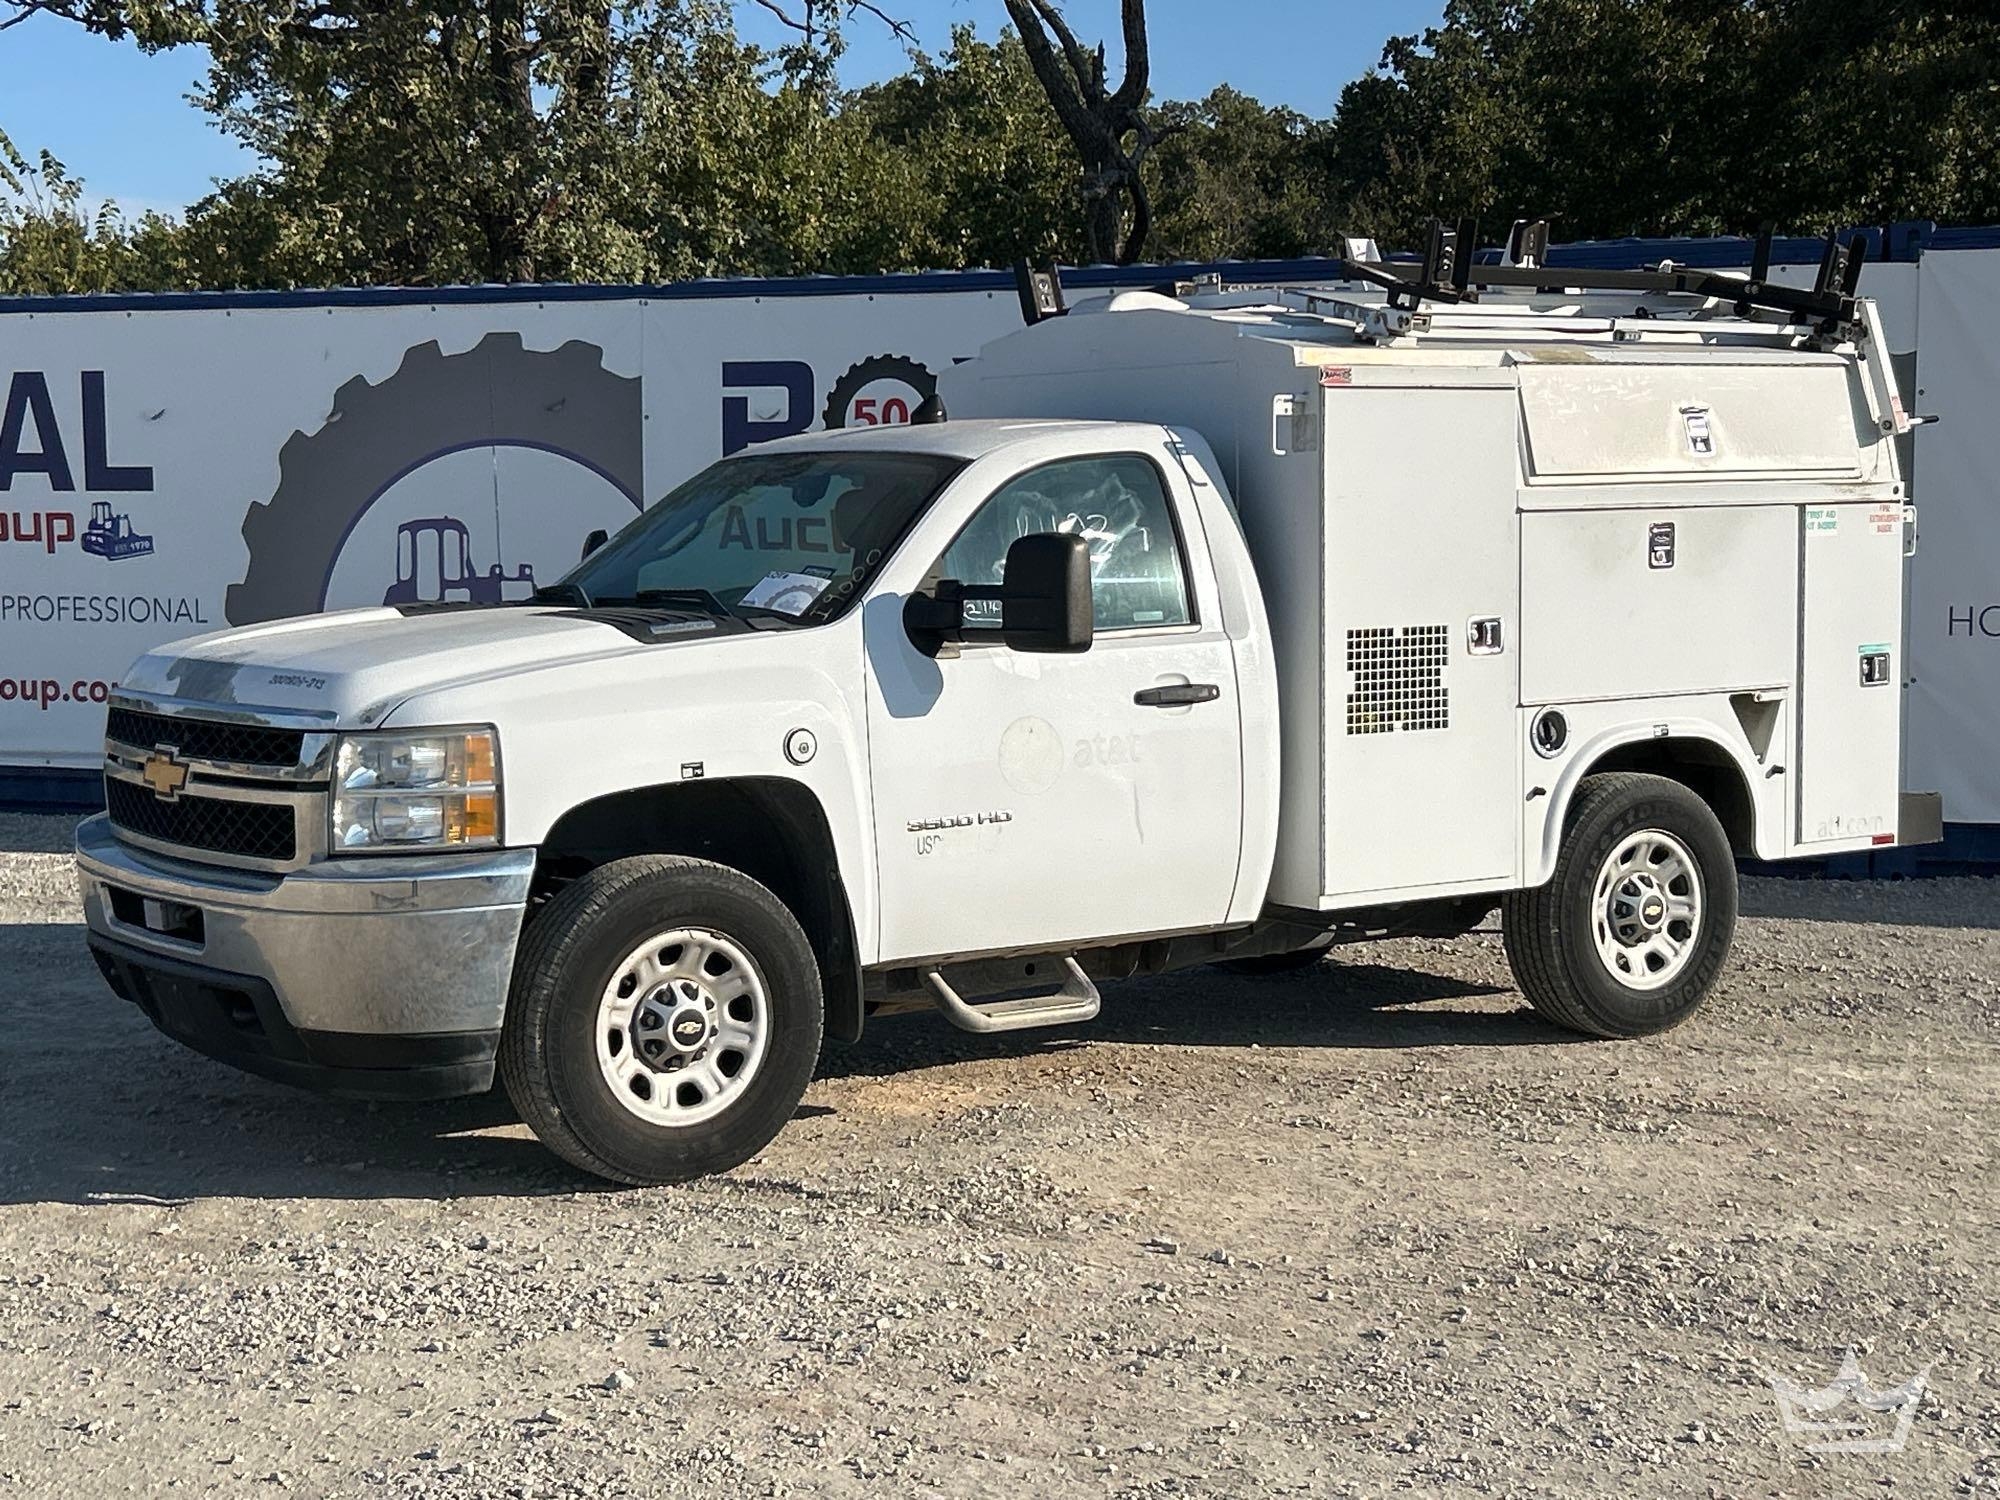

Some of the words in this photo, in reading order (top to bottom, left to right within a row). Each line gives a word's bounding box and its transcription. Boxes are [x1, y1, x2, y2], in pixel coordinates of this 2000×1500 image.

[854, 398, 909, 425] 50
[1, 595, 209, 624] PROFESSIONAL
[0, 678, 120, 711] oup.co
